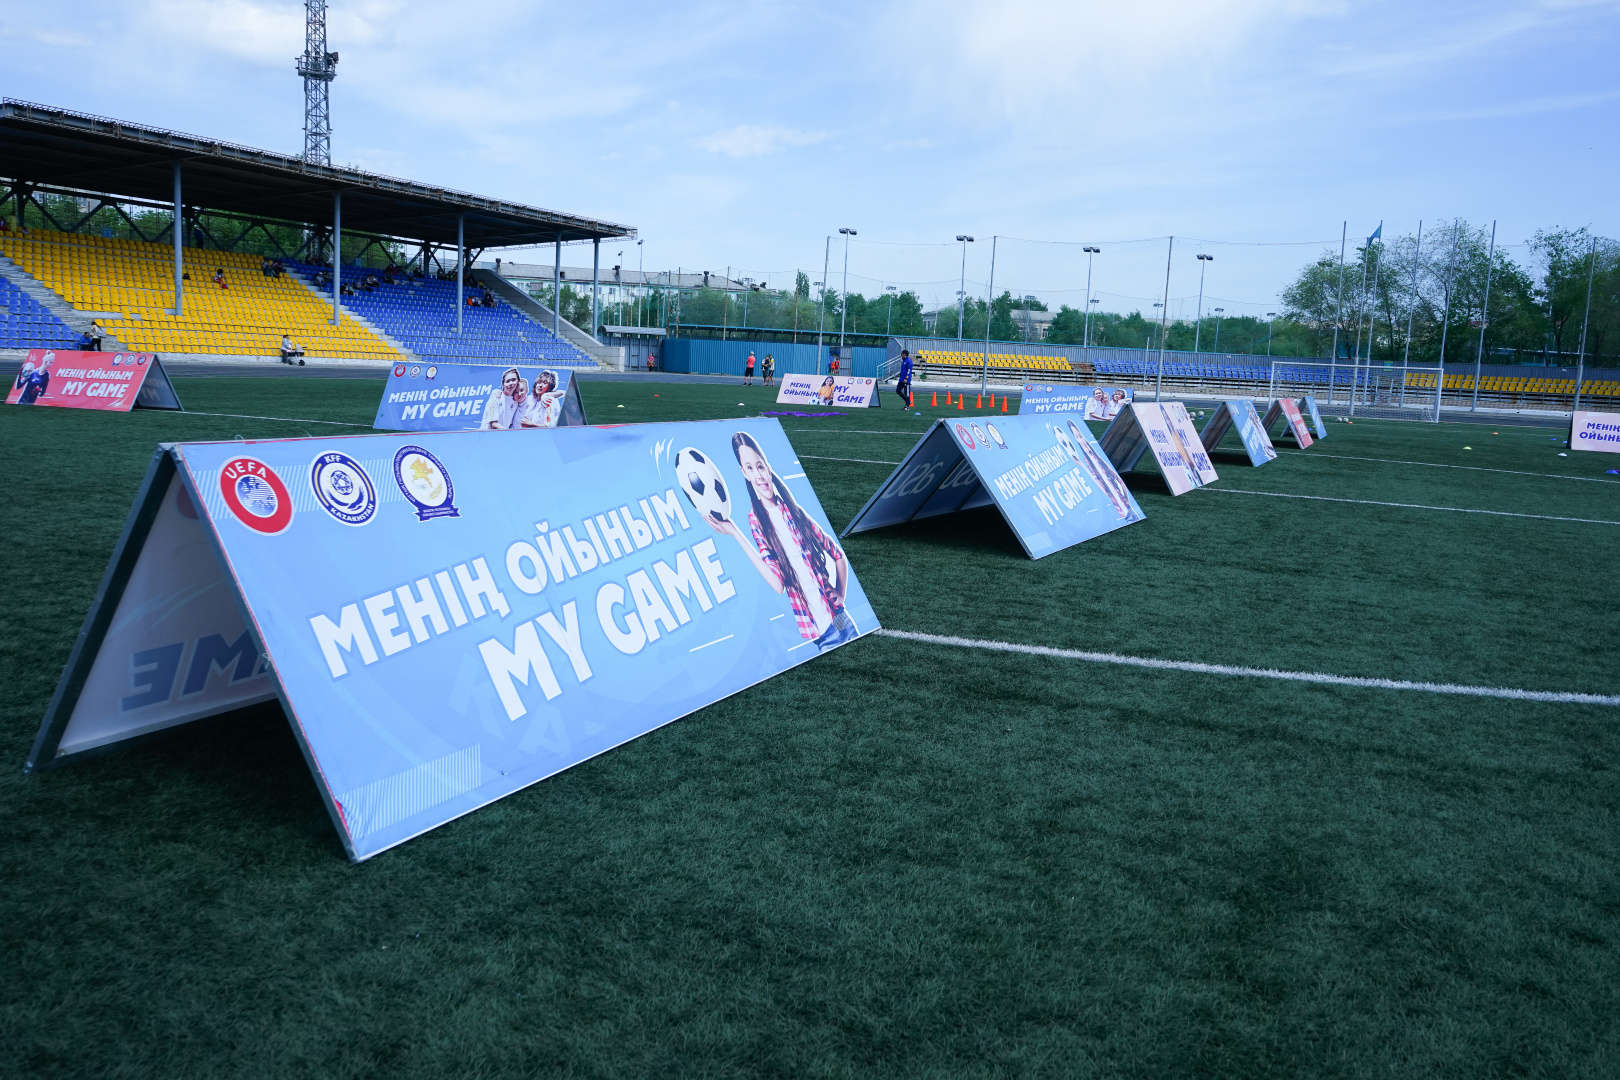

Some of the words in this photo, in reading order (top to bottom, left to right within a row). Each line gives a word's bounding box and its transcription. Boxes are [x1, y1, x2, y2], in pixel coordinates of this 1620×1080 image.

[86, 368, 134, 380] ОЙЫНЫМ
[61, 381, 87, 396] MY
[86, 382, 130, 398] GAME
[388, 389, 427, 404] МЕНІҢ
[430, 384, 492, 398] ОЙЫНЫМ
[834, 385, 850, 393] MY
[837, 394, 865, 404] GAME
[1035, 404, 1051, 412] MY
[1054, 403, 1084, 412] GAME
[401, 404, 430, 420] MY
[432, 400, 485, 418] GAME
[324, 454, 342, 464] KFF
[225, 462, 266, 479] UEFA
[994, 465, 1034, 500] МЕНІҢ
[1024, 444, 1069, 482] ОЙЫНЫМ
[1032, 486, 1064, 526] MY
[1054, 467, 1092, 510] GAME
[330, 504, 374, 523] KAZAKHSTAN
[309, 557, 512, 678] МЕНІҢ
[505, 489, 691, 595] ОЙЫНЫМ
[478, 600, 594, 722] MY
[596, 538, 737, 655] GAME
